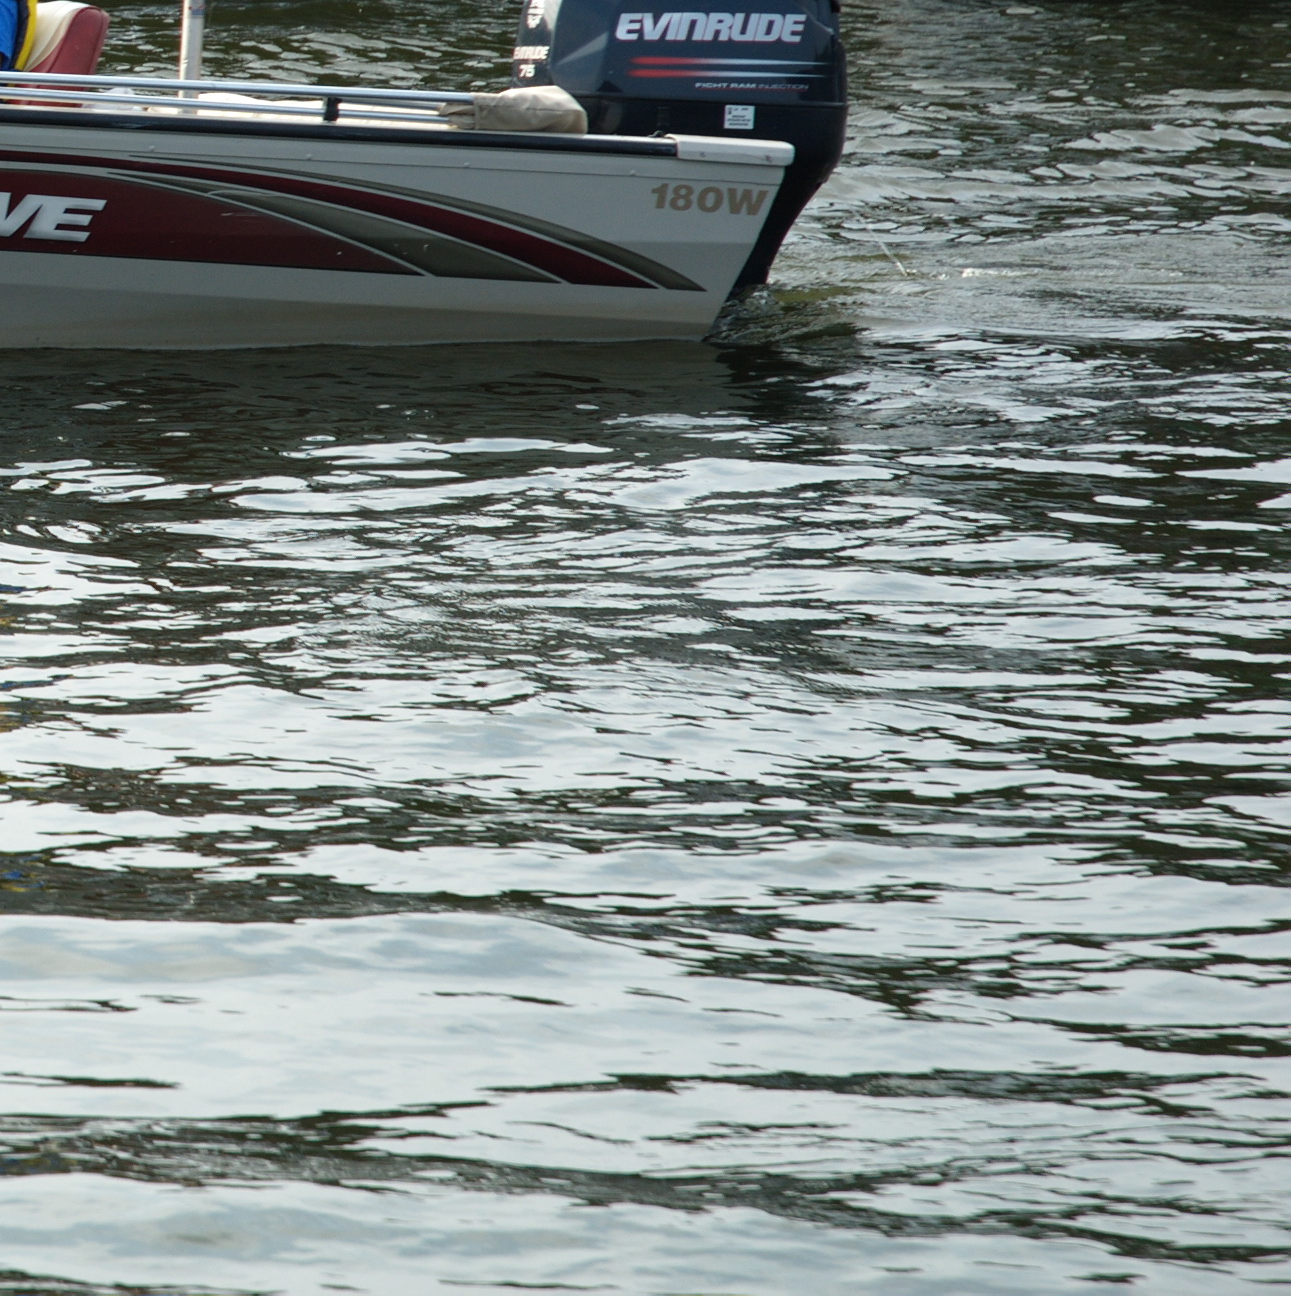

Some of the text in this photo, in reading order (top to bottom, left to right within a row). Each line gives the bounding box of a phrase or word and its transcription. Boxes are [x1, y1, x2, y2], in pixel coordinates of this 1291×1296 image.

[616, 12, 807, 43] EVINRUDE
[519, 64, 536, 78] 75
[651, 182, 769, 216] 180W
